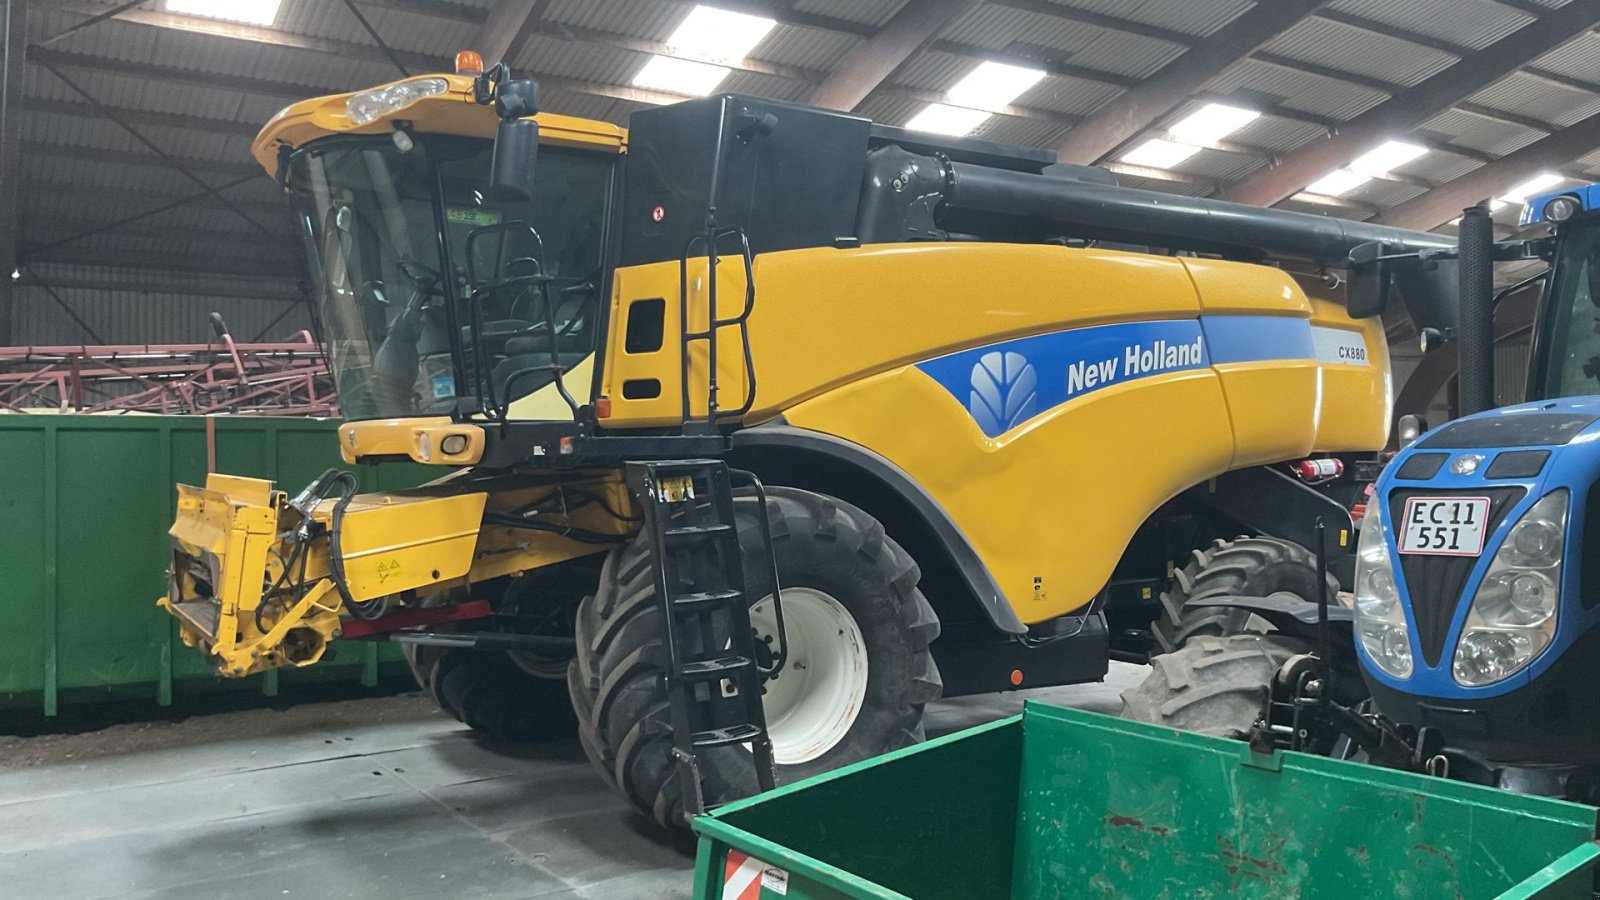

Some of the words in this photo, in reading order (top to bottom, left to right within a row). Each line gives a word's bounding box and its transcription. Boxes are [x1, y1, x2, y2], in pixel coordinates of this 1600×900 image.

[1067, 357, 1119, 395] New
[1124, 335, 1202, 377] Holland
[1338, 346, 1365, 361] CX880
[1416, 527, 1460, 550] 551
